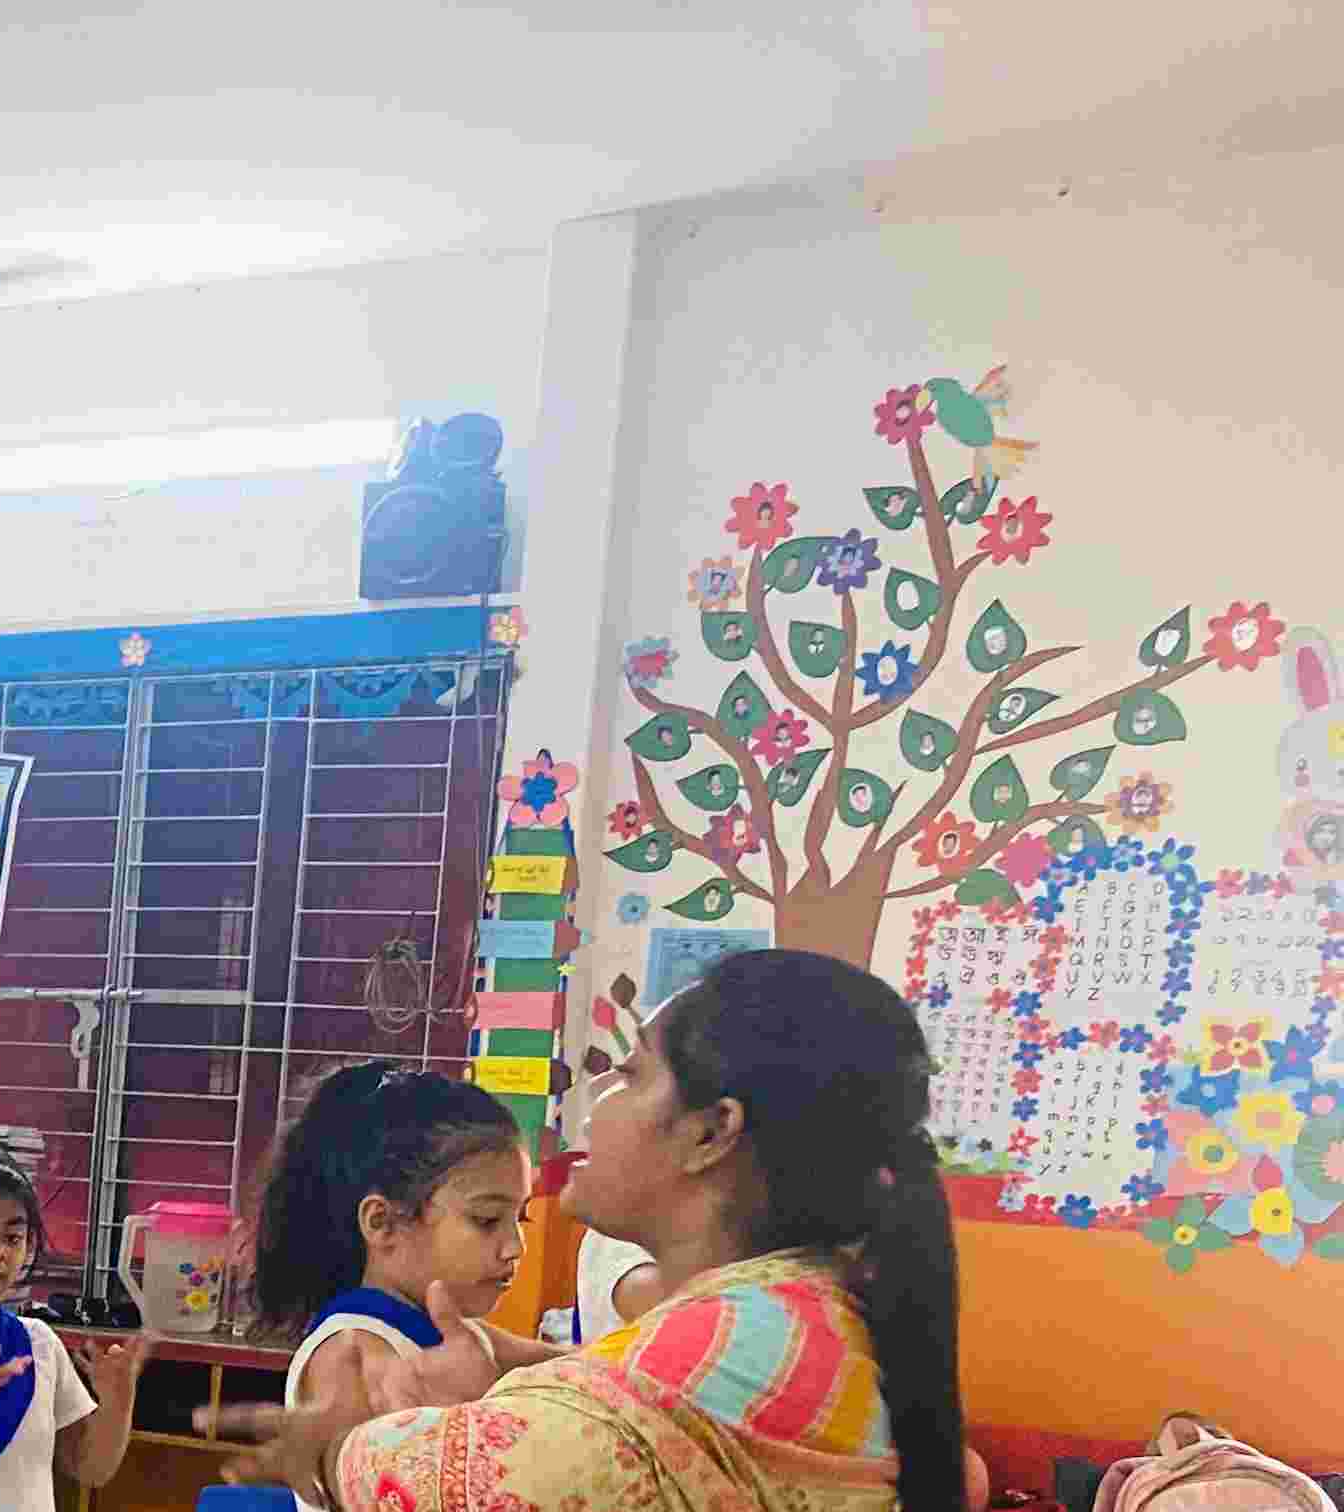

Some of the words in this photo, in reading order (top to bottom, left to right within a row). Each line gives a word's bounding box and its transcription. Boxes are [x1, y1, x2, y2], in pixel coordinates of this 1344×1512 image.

[1093, 951, 1105, 967] R
[1139, 952, 1153, 969] T
[1065, 967, 1081, 985] U
[1091, 967, 1106, 984] V
[1112, 968, 1132, 985] W
[1064, 984, 1080, 1000] Y
[1088, 986, 1100, 1001] Z
